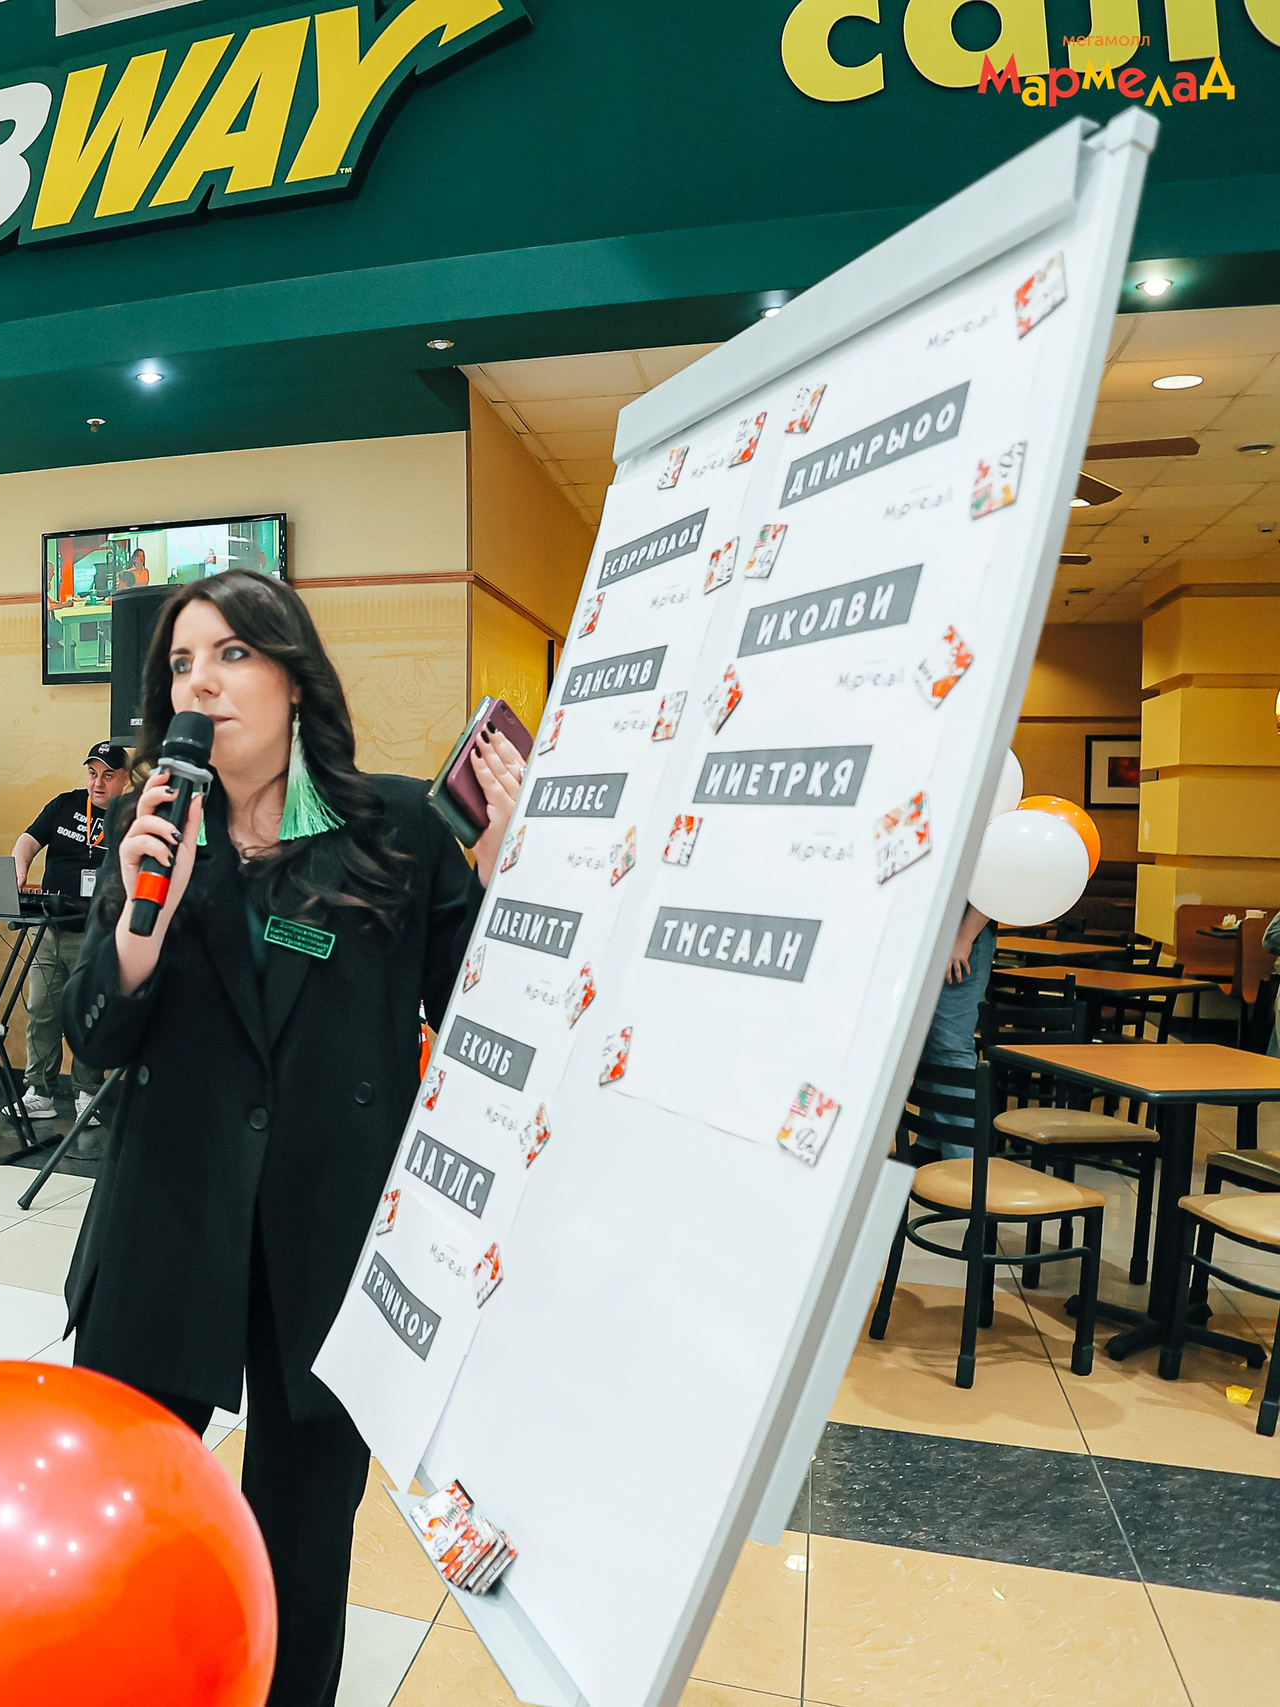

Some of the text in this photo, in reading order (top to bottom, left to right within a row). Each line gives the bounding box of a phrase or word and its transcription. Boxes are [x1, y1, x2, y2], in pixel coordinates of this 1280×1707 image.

[780, 0, 1280, 102] сал
[755, 583, 896, 647] ИКОЛВИ
[57, 826, 85, 842] SOUND
[459, 1031, 513, 1076] ЕКОНБ
[409, 1139, 486, 1211] ААТЛС
